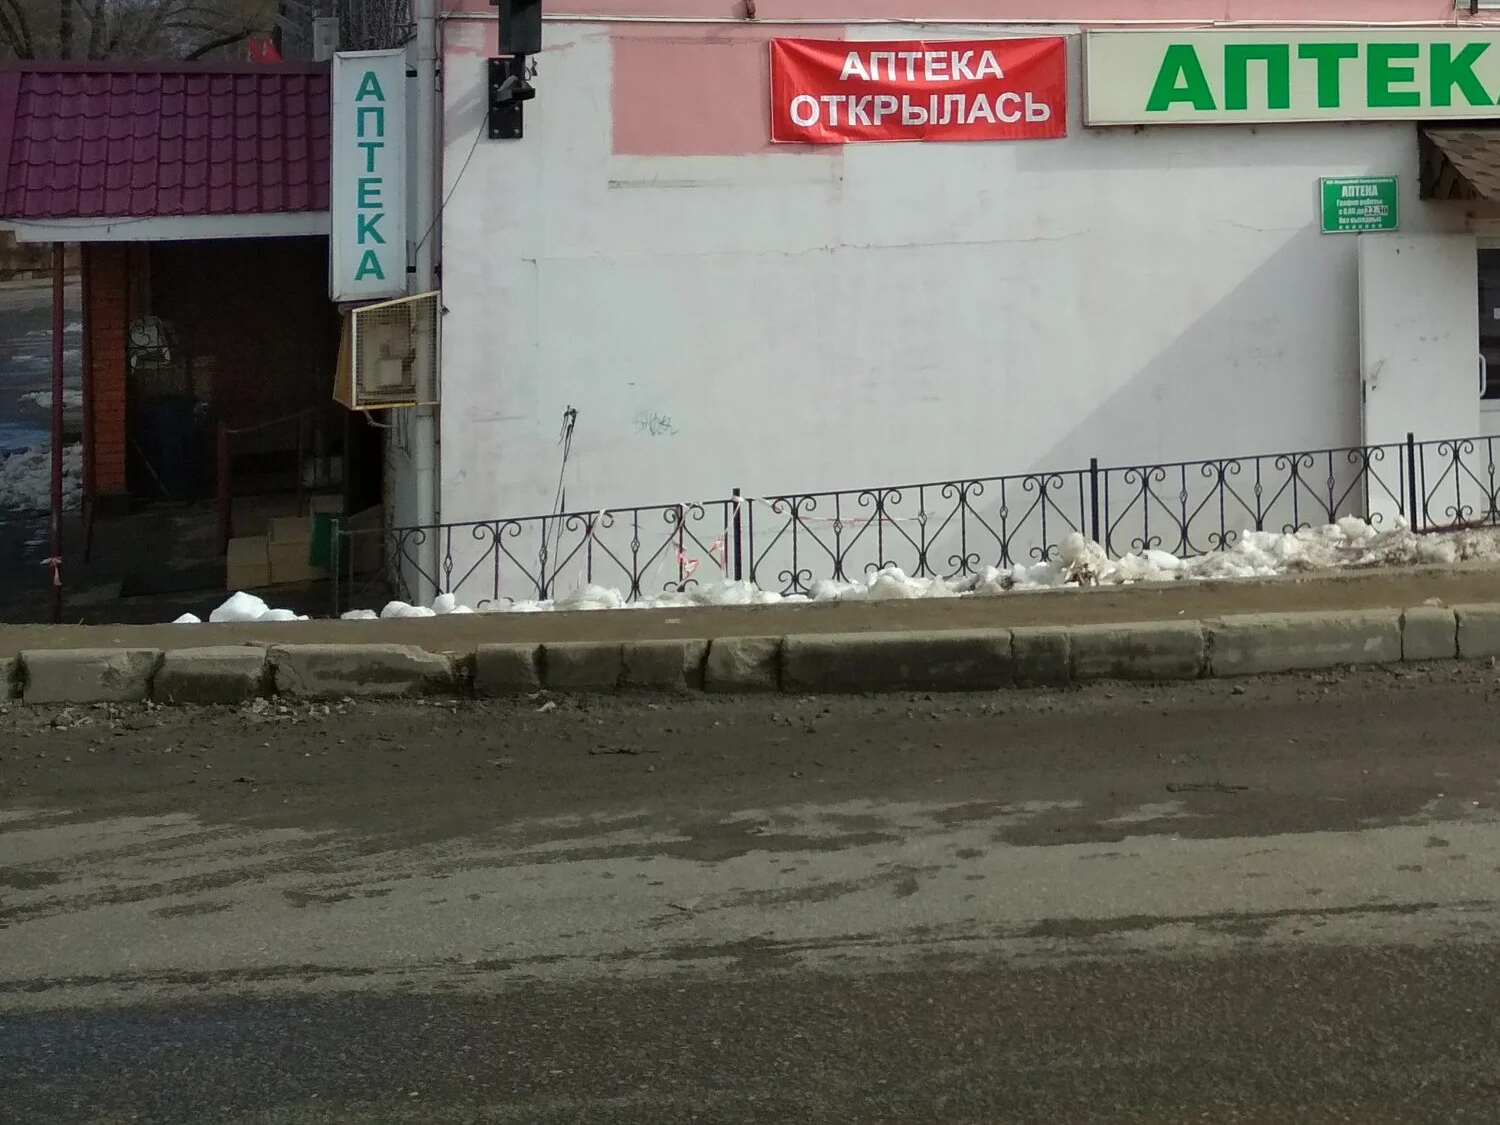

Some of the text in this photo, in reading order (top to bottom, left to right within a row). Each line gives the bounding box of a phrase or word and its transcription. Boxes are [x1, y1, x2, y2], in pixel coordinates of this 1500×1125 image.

[840, 49, 1004, 82] АПТЕКА
[788, 91, 1052, 128] ОТКРЫЛАСЬ
[353, 71, 387, 281] АПТЕКА
